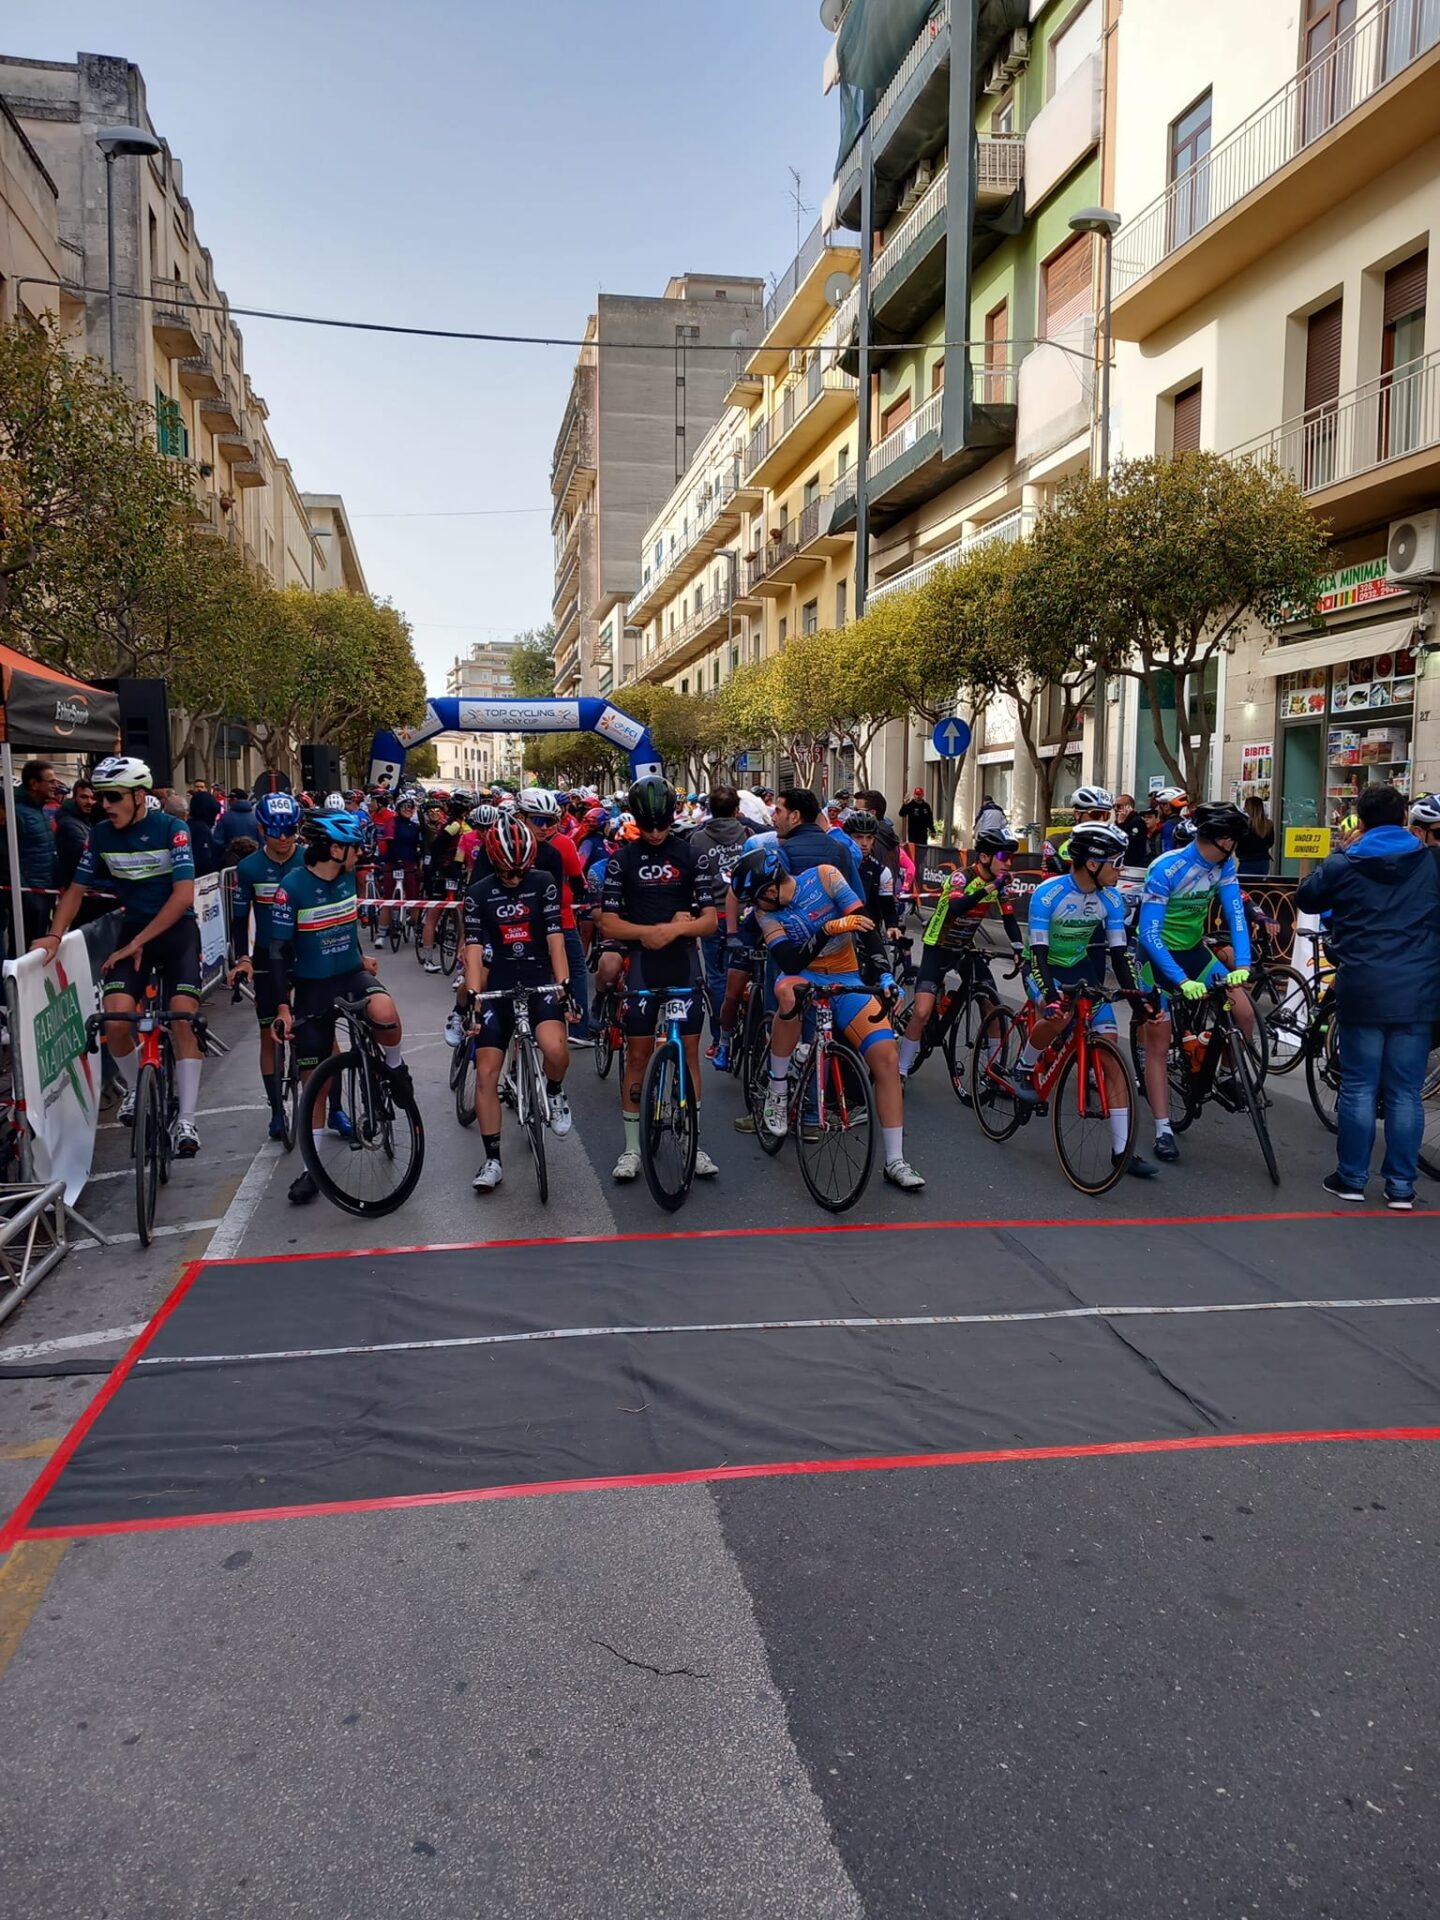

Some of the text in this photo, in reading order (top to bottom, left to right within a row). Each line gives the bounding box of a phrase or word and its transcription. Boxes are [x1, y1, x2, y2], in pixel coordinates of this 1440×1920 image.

[485, 708, 555, 717] TOP CYCLING
[1419, 710, 1431, 722] 27
[1244, 745, 1271, 757] BIBITE
[269, 799, 290, 809] 466
[1294, 834, 1312, 842] UNDER
[666, 1001, 685, 1016] 464
[36, 990, 79, 1049] FARMACIA
